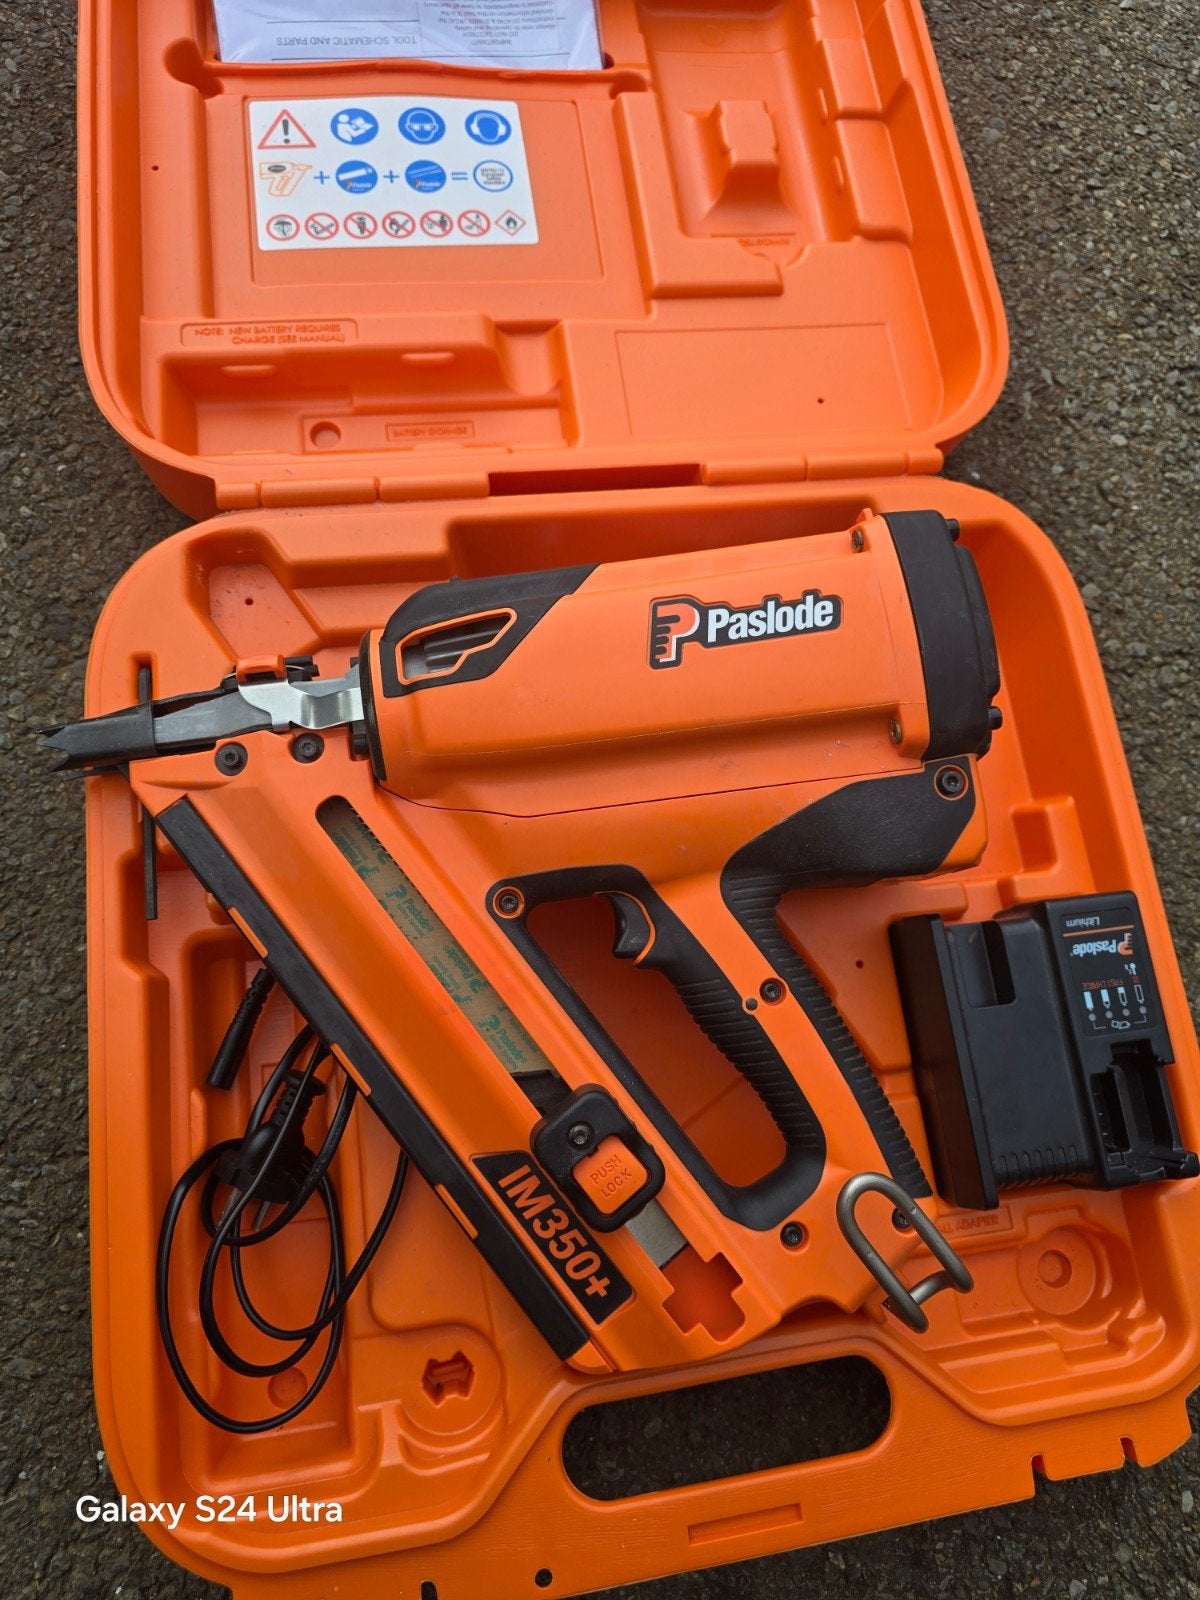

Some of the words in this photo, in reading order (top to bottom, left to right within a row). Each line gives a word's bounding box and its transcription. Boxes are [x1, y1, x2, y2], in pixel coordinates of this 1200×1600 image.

[276, 36, 308, 46] PARTS
[310, 37, 332, 46] AND
[334, 36, 389, 46] SCHEMATIC
[392, 36, 417, 45] TOOL
[194, 328, 224, 336] NOTE:
[229, 326, 251, 336] NEW
[254, 325, 293, 334] BATTERY
[295, 324, 341, 334] REQUIRES
[232, 335, 276, 345] CHARGE
[278, 334, 297, 345] (SEE
[299, 333, 345, 344] MANUAL)
[707, 594, 834, 643] Paslode
[1066, 916, 1100, 928] Lithium
[1072, 939, 1117, 958] Paslode
[1080, 980, 1106, 990] CHARGE
[590, 1154, 622, 1185] PUSH
[600, 1168, 632, 1199] LOCK
[498, 1164, 611, 1298] IM350+
